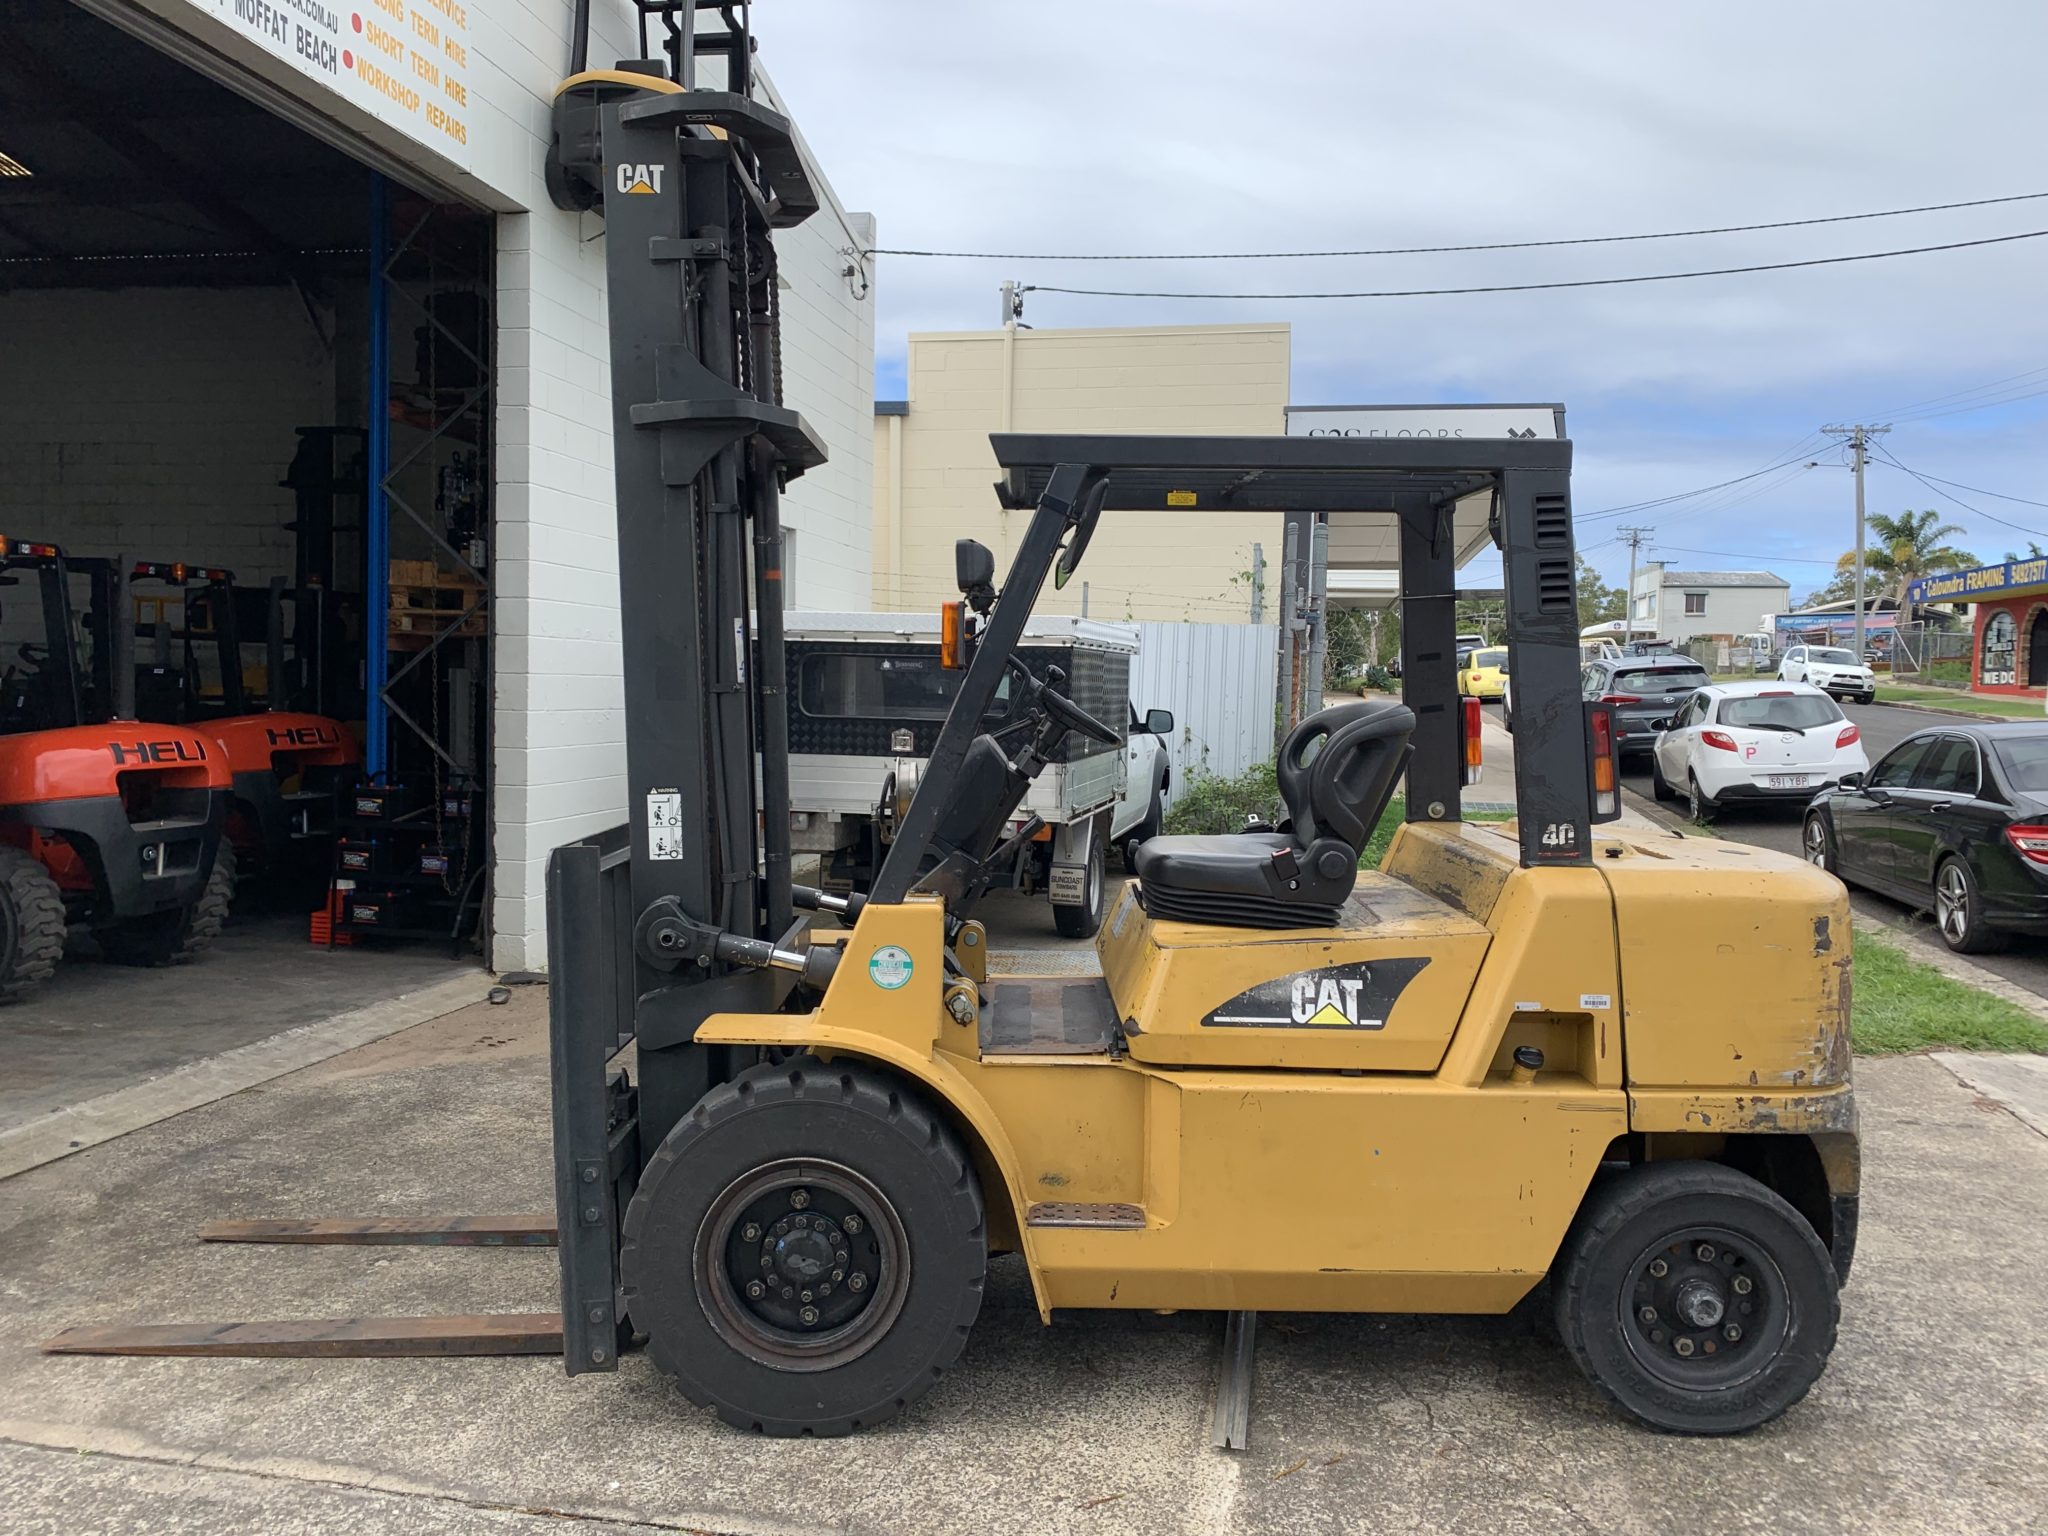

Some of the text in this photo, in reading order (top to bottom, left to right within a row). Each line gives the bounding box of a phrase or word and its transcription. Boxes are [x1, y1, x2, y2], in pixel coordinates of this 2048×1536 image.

[233, 0, 337, 75] MOFFAT BEACH
[410, 9, 439, 48] TERM
[445, 35, 466, 69] HIRE
[366, 20, 467, 108] SHORT TERM HIRE
[356, 55, 467, 146] WORKSHOP REPAIRS
[617, 163, 664, 194] CAT
[1966, 566, 2005, 590] FRAMING
[1983, 671, 1999, 685] WE
[266, 728, 342, 746] HELI
[109, 741, 207, 764] HELI
[1746, 747, 1757, 760] P
[1051, 875, 1083, 885] SUNCOAST
[1291, 975, 1364, 1026] CAT
